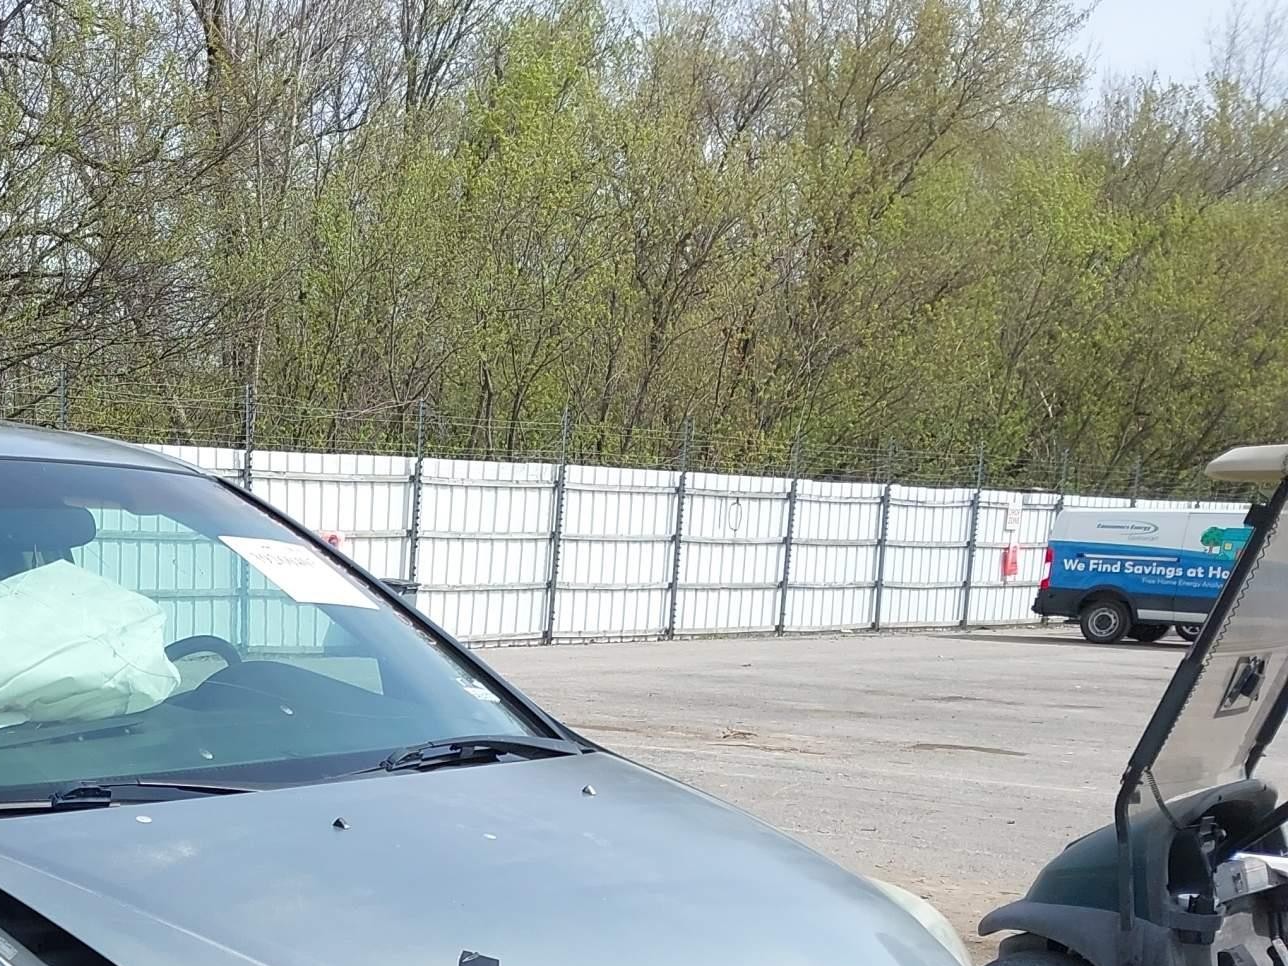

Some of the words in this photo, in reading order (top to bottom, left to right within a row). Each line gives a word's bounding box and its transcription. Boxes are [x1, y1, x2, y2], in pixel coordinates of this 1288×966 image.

[1063, 559, 1086, 572] We
[1089, 560, 1121, 574] Find
[1124, 562, 1183, 579] Savings
[1187, 567, 1205, 578] at
